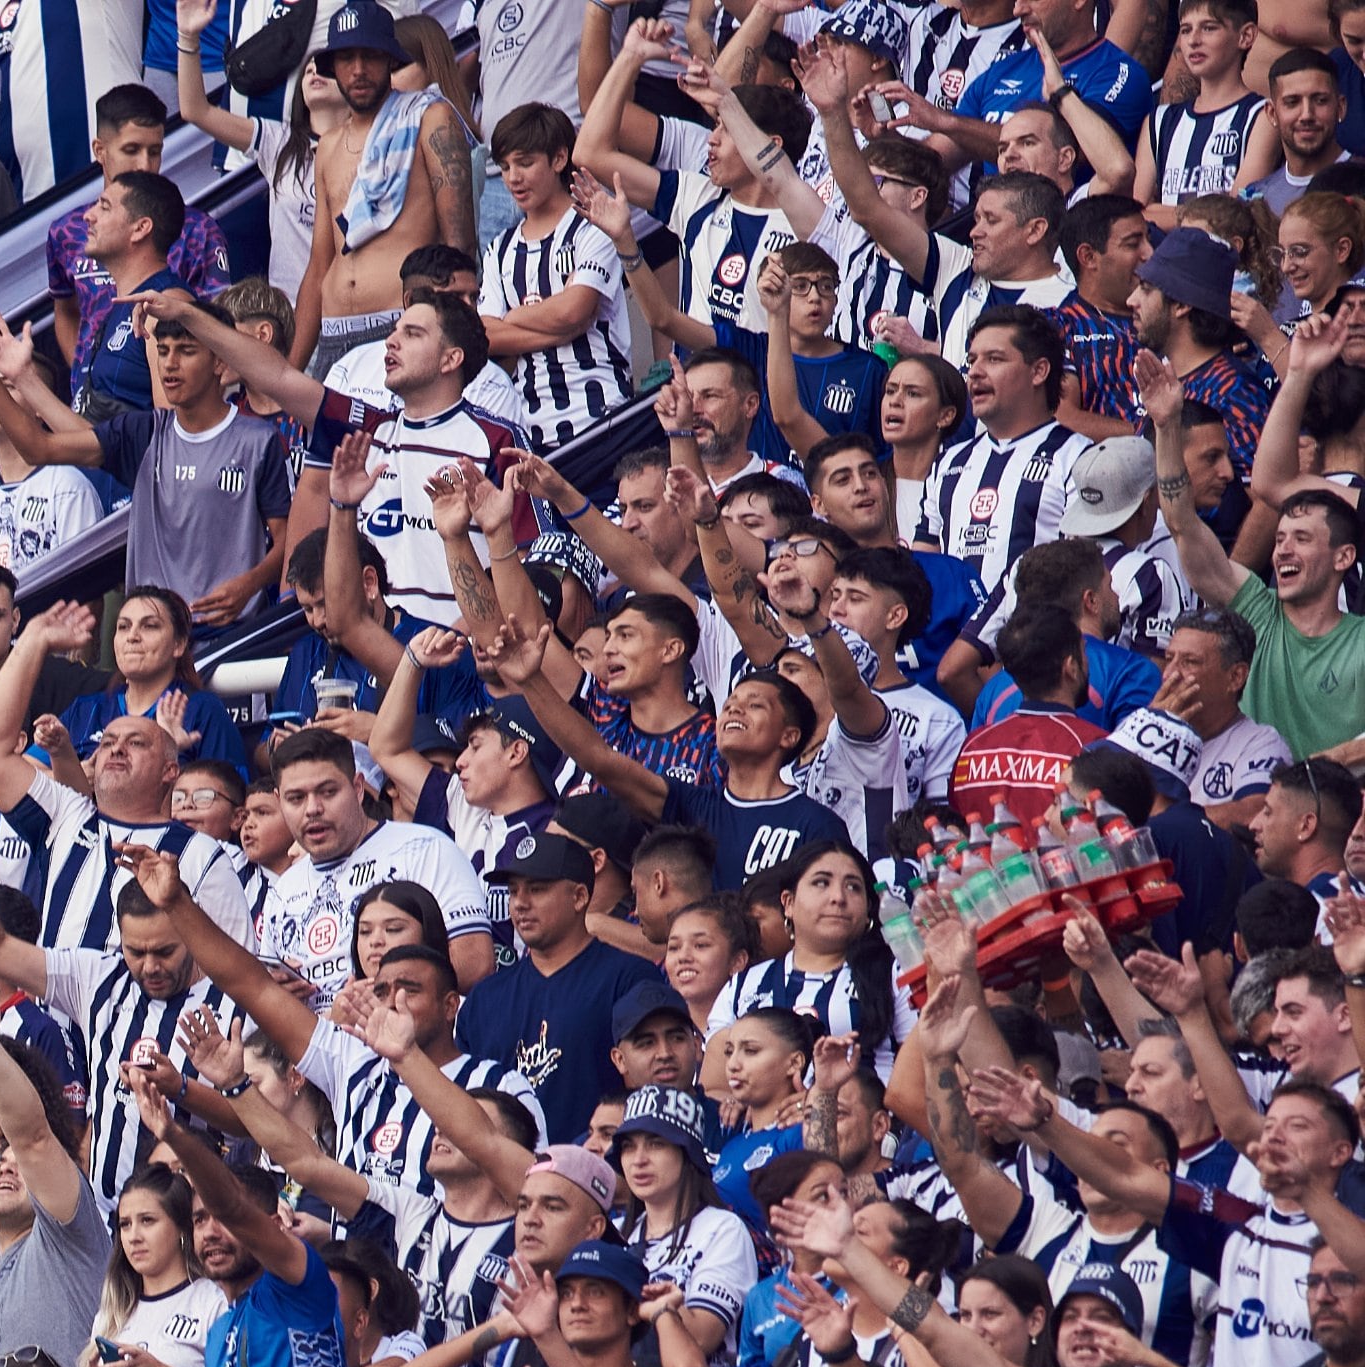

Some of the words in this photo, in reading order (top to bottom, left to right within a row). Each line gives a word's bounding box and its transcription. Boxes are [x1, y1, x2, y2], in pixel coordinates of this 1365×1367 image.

[491, 33, 526, 57] ICBC
[299, 202, 314, 217] IC
[709, 283, 745, 309] ICBC
[175, 464, 197, 481] 175
[959, 524, 998, 541] ICBC
[957, 544, 995, 556] Argentina
[1136, 723, 1200, 775] CAT
[968, 756, 1059, 783] MAXIMA
[745, 826, 800, 873] CAT
[306, 955, 347, 983] ICBC
[699, 1283, 739, 1310] Riiing
